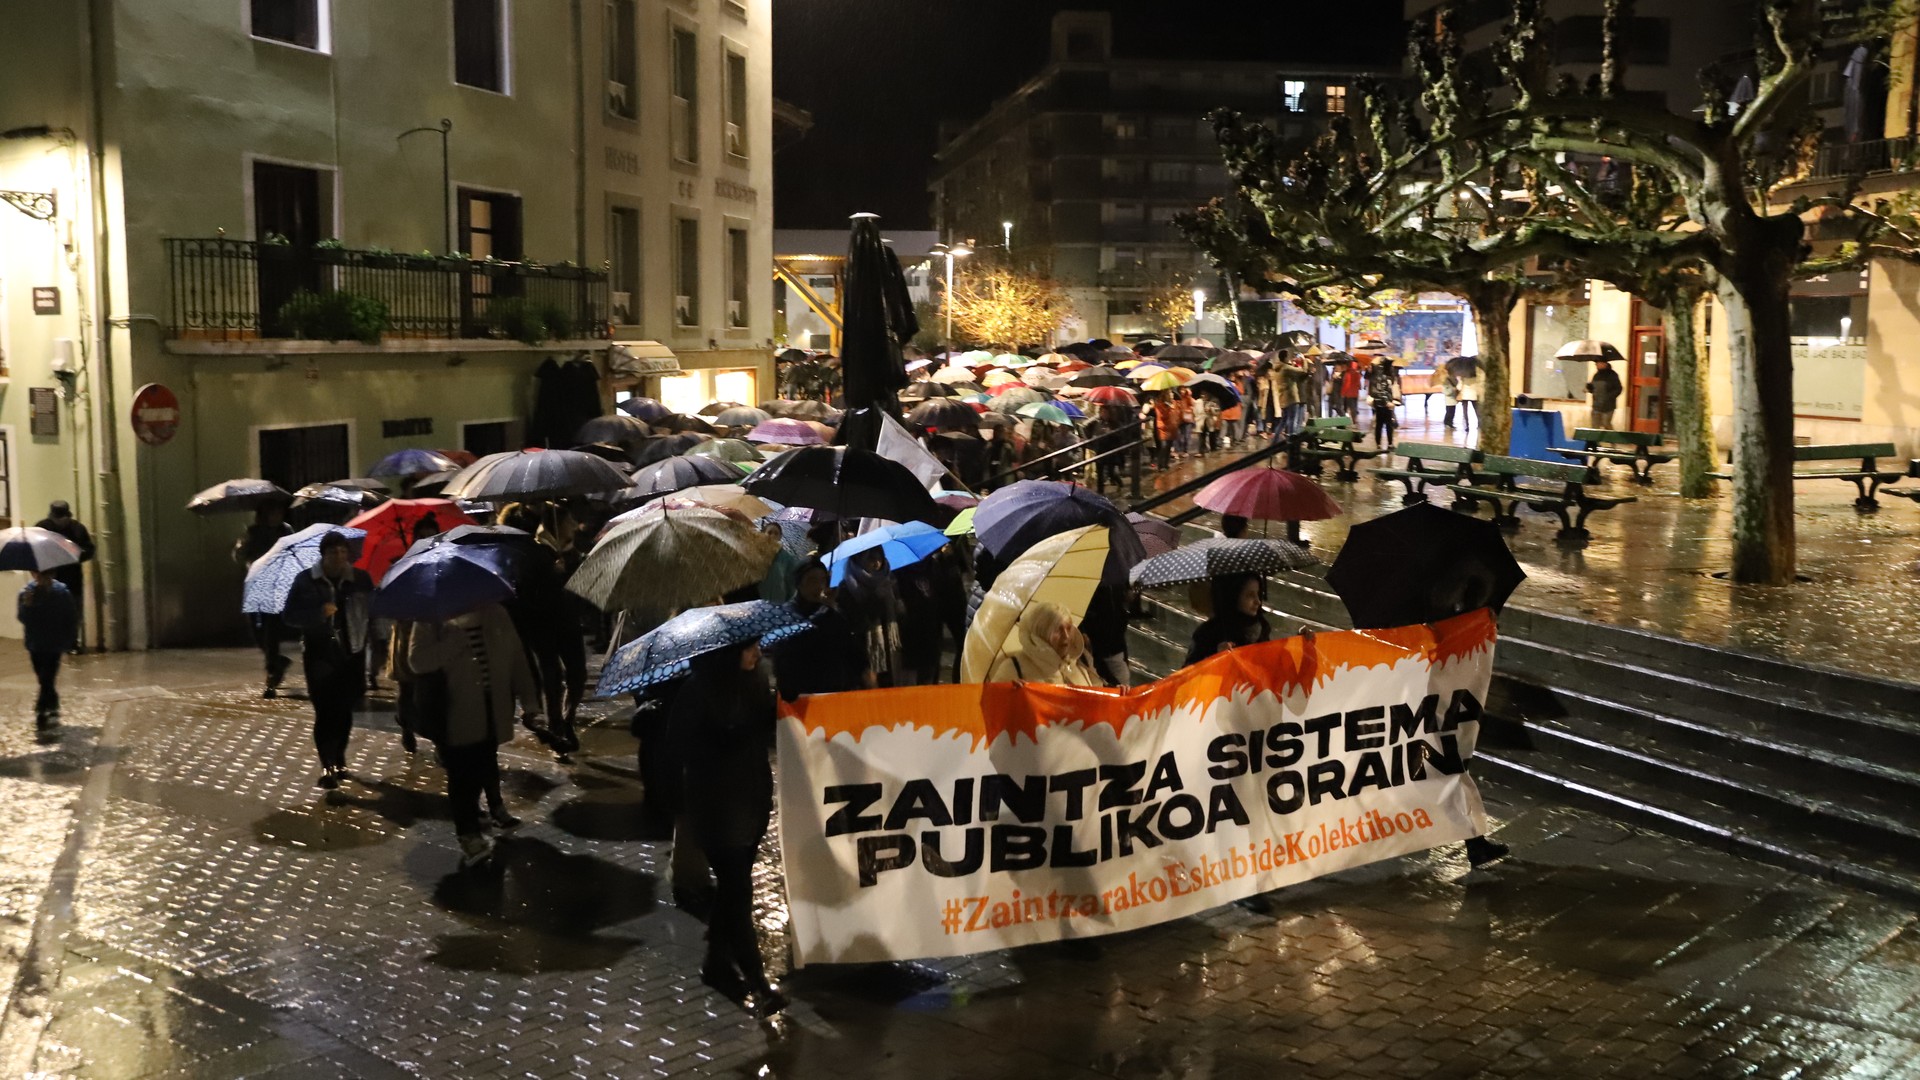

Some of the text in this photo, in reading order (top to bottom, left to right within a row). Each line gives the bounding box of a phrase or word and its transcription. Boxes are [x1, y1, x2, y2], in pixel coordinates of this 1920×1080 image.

[823, 688, 1483, 837] ZAINTZA SISTEMA
[857, 784, 1250, 888] PUBLIKOA
[940, 803, 1433, 936] #ZaintzarakoEskubideKolektiboa
